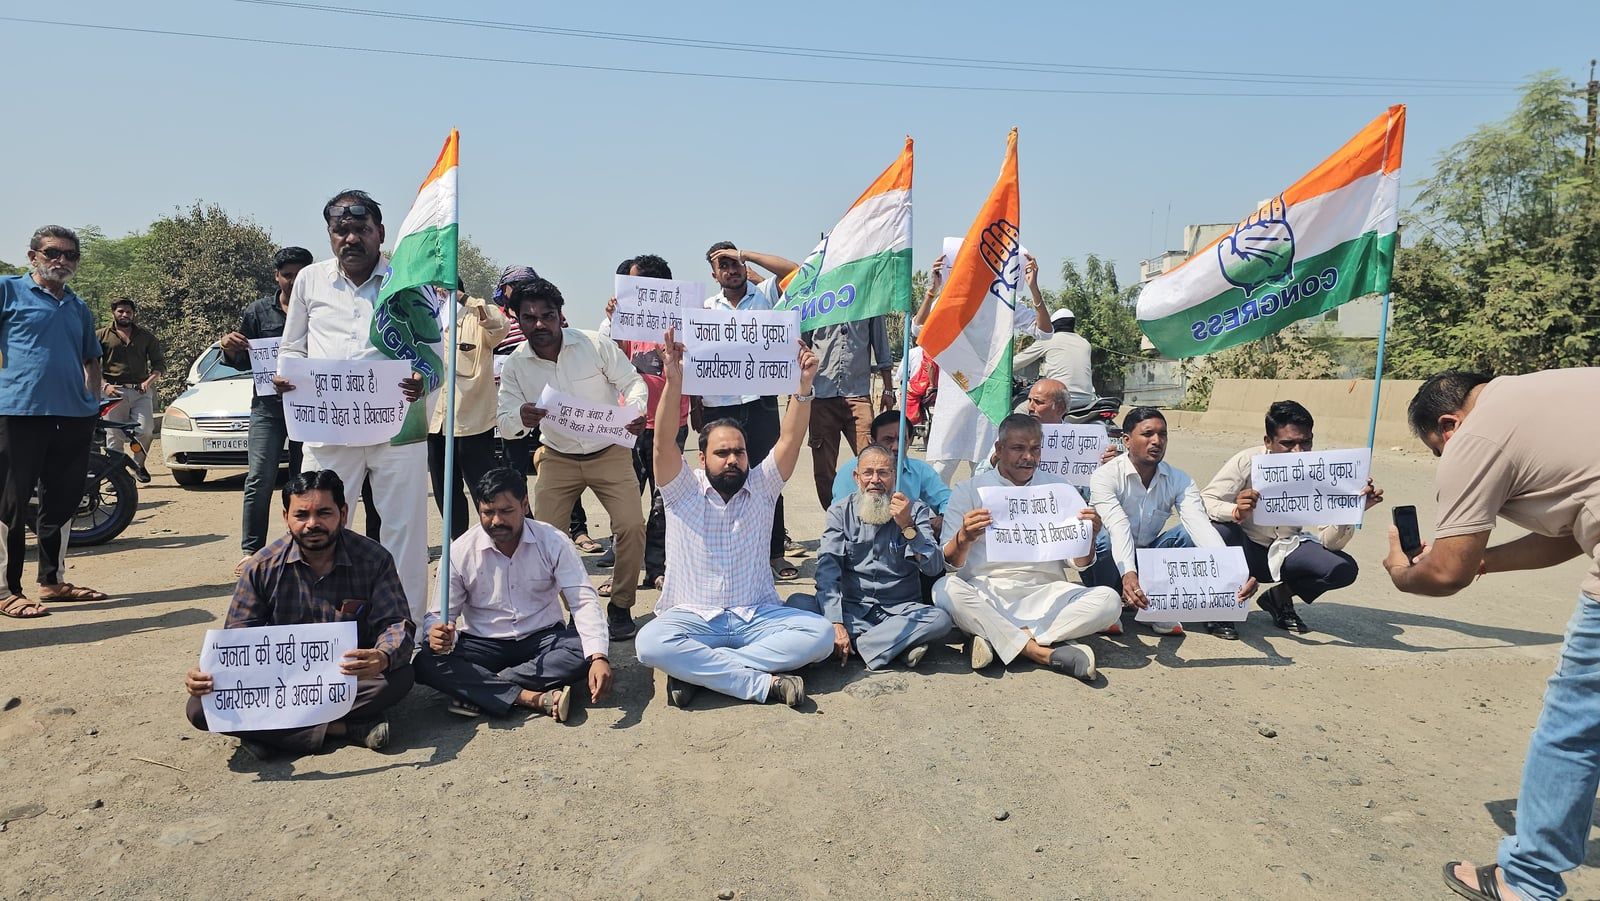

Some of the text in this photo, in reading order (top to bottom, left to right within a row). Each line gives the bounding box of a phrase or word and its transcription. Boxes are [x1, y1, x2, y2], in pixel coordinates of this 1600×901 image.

[649, 289, 657, 302] का
[659, 286, 673, 304] अंबार
[637, 309, 644, 327] की
[647, 310, 659, 330] सेहत
[662, 312, 667, 329] से
[670, 312, 682, 331] खिल
[689, 318, 720, 342] "जनता
[724, 317, 737, 342] की
[741, 318, 758, 343] यही
[691, 353, 741, 379] "डामरीकरण
[745, 353, 754, 380] हो
[310, 368, 378, 397] "धूल का अंबार है।
[290, 402, 315, 423] "जनता
[318, 401, 328, 424] की
[331, 402, 349, 426] सेहत
[353, 402, 361, 424] से
[574, 408, 584, 418] का
[559, 417, 568, 426] की
[570, 420, 585, 432] सेहत
[587, 423, 594, 433] से
[212, 440, 248, 449] MP04CF8
[1048, 430, 1058, 449] की
[1061, 430, 1075, 450] यही
[1040, 456, 1098, 475] करण हो तत्काल
[1258, 464, 1288, 483] "जनता
[1292, 458, 1304, 481] की
[1309, 458, 1325, 481] यही
[1020, 499, 1028, 514] का
[1031, 494, 1047, 514] अंबार
[1049, 491, 1058, 514] है।
[1314, 489, 1323, 512] हो
[1012, 524, 1022, 544] की
[1023, 524, 1039, 546] सेहत
[1040, 523, 1048, 544] से
[1180, 561, 1190, 577] का
[1191, 557, 1208, 577] अंबार
[1210, 554, 1220, 578] है।
[1170, 587, 1179, 610] की
[1182, 587, 1197, 610] सेहत
[1200, 587, 1206, 609] से
[213, 642, 250, 667] "जनता
[255, 635, 270, 665] की
[276, 634, 296, 666] यही
[213, 675, 350, 710] डामरीकरण हो अबकी बार।
